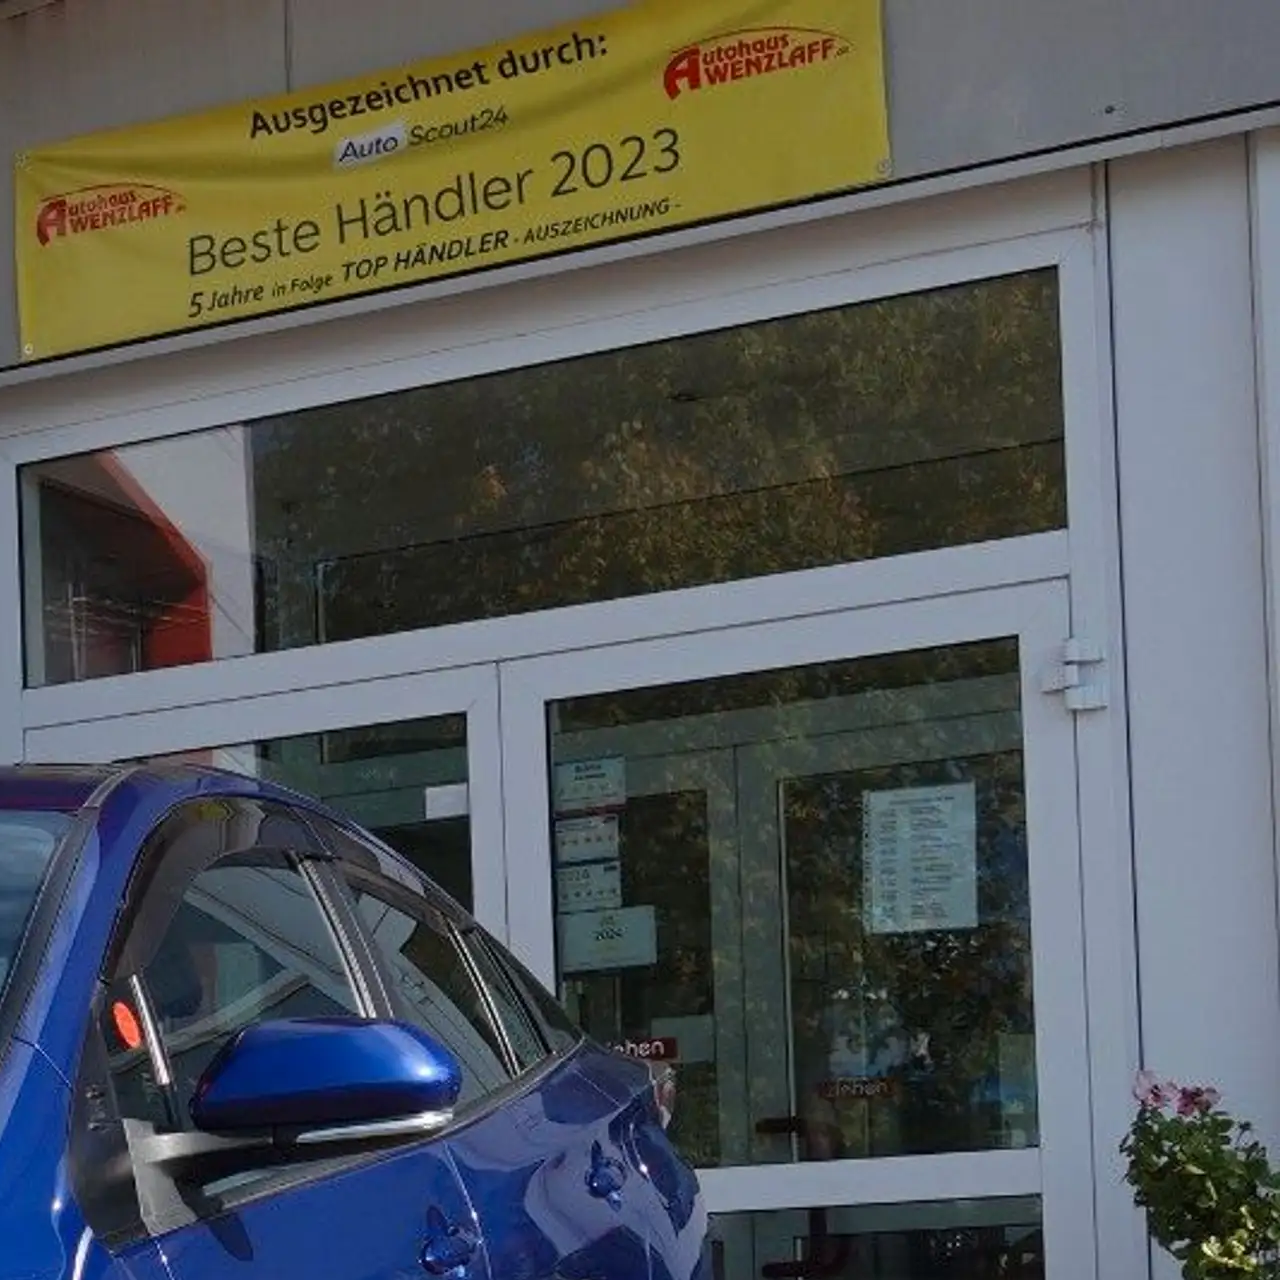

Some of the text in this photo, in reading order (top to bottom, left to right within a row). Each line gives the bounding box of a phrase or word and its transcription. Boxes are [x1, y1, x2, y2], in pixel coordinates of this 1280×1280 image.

[249, 32, 609, 138] Ausgezeichnet durch:
[338, 105, 510, 163] Auto Scout24
[188, 128, 680, 276] Beste Händler 2023
[188, 292, 203, 318] 5
[207, 283, 264, 312] Jahre
[272, 281, 288, 299] in
[290, 271, 333, 294] Folge
[341, 256, 385, 284] TOP
[394, 230, 509, 271] HÄNDLER
[523, 198, 670, 246] AUSZEICHNUNG
